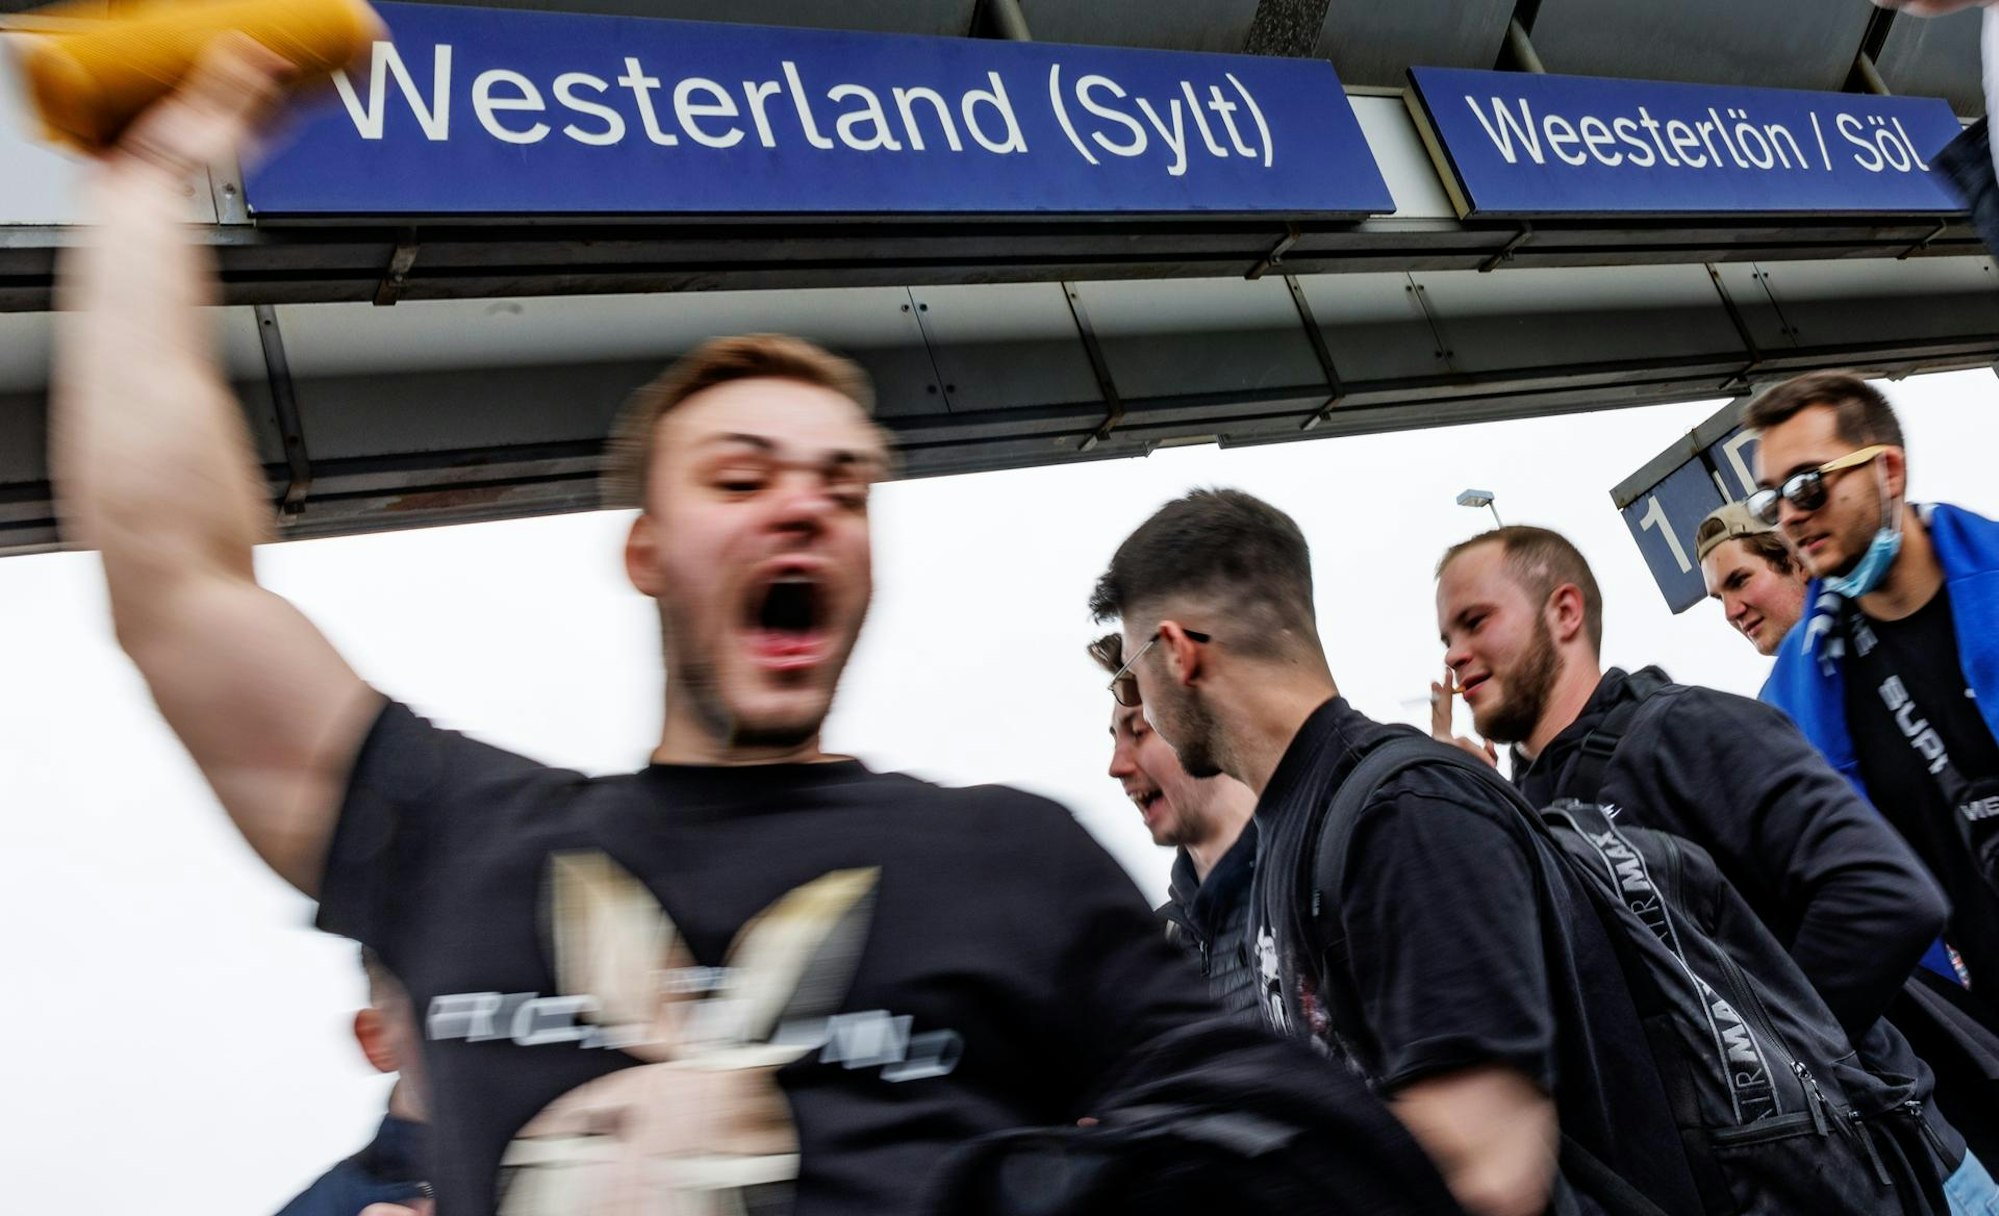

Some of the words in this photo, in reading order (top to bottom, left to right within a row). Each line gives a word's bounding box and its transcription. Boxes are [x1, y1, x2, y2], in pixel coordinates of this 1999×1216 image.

[330, 40, 1028, 153] Westerland
[1049, 64, 1272, 177] (Sylt)
[1465, 95, 1809, 171] Weesterlön
[1836, 112, 1930, 173] Söl
[1640, 495, 1692, 575] 1
[1630, 895, 1668, 940] IR
[1702, 983, 1759, 1062] MA
